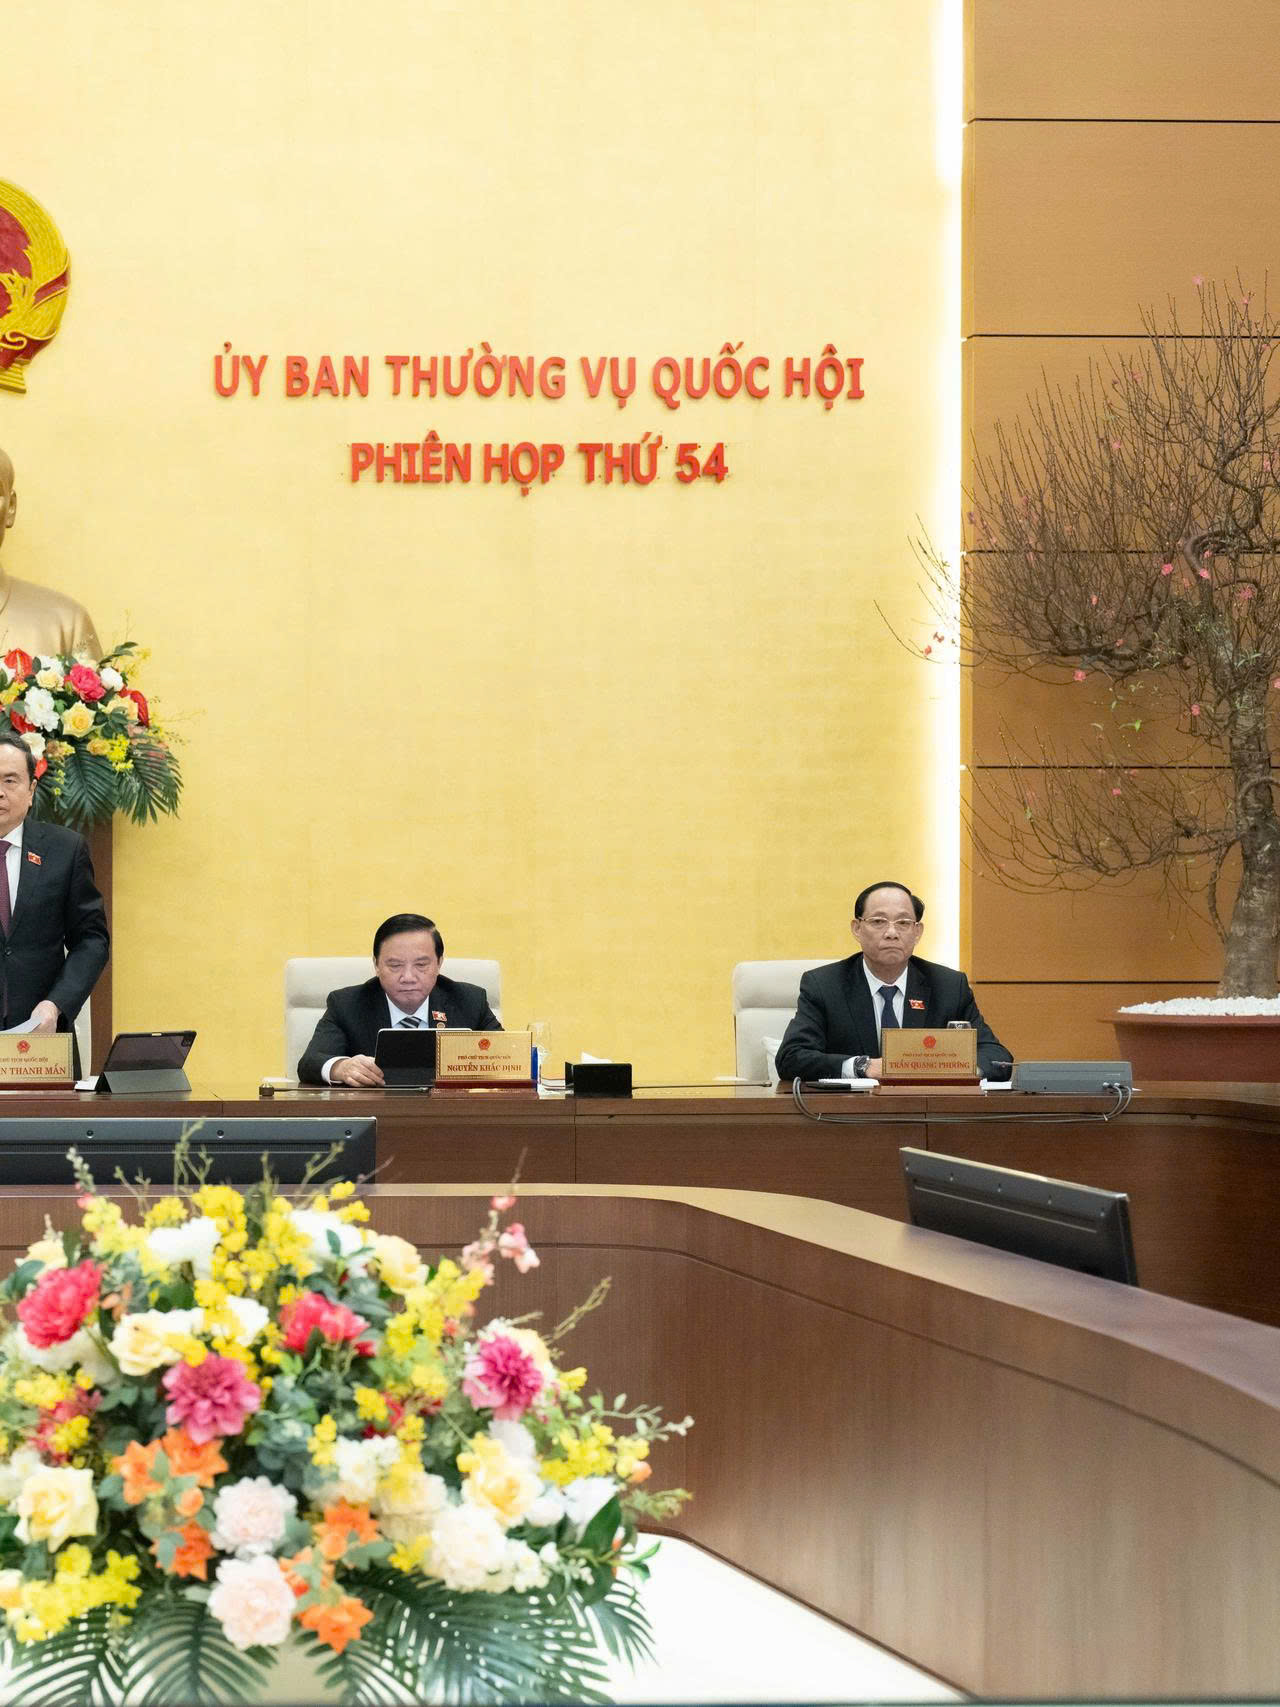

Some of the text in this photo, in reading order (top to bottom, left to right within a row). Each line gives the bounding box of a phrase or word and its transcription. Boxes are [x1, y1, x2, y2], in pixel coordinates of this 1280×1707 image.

[214, 342, 864, 410] ỦY BAN THƯỜNG VỤ QUỐC HỘI
[351, 431, 729, 496] PHIÊN HỌP THỨ 54
[9, 1066, 43, 1075] THANH
